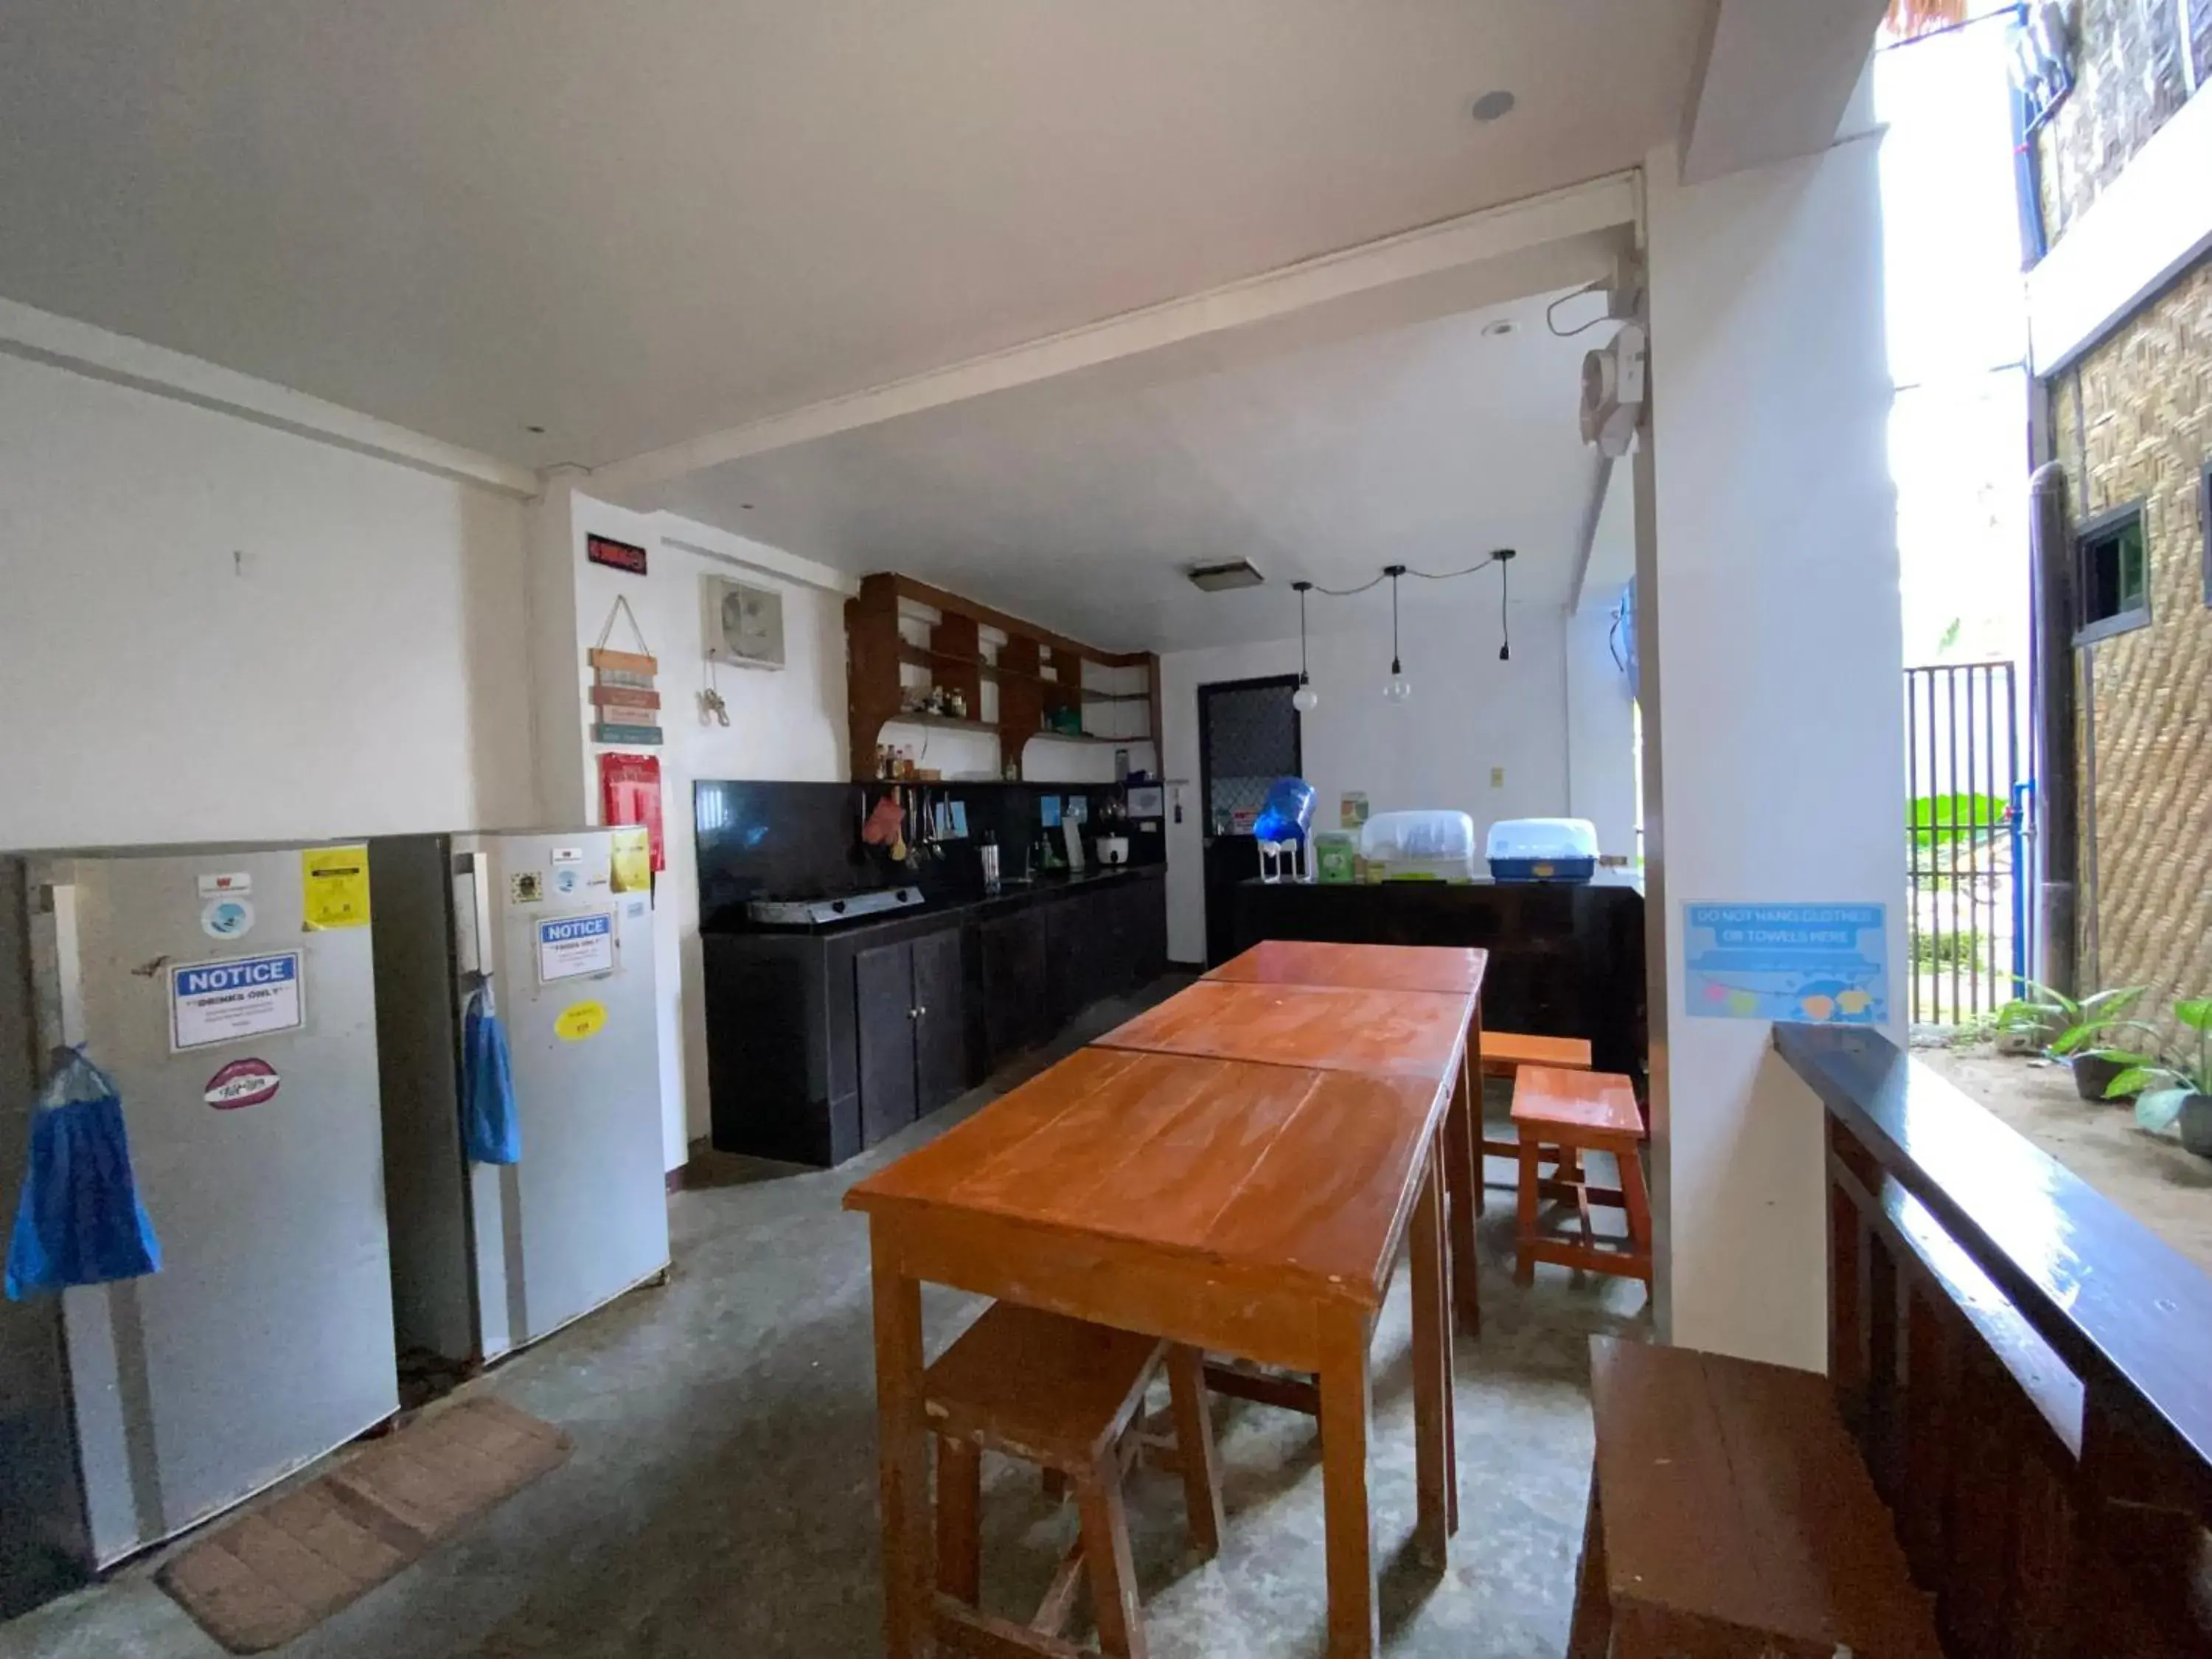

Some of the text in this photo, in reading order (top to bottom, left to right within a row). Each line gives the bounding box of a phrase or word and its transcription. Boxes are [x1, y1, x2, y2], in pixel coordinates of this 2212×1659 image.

[1697, 910, 1719, 922] DO
[1722, 910, 1751, 922] NOT
[549, 919, 603, 940] NOTICE
[189, 961, 285, 992] NOTICE
